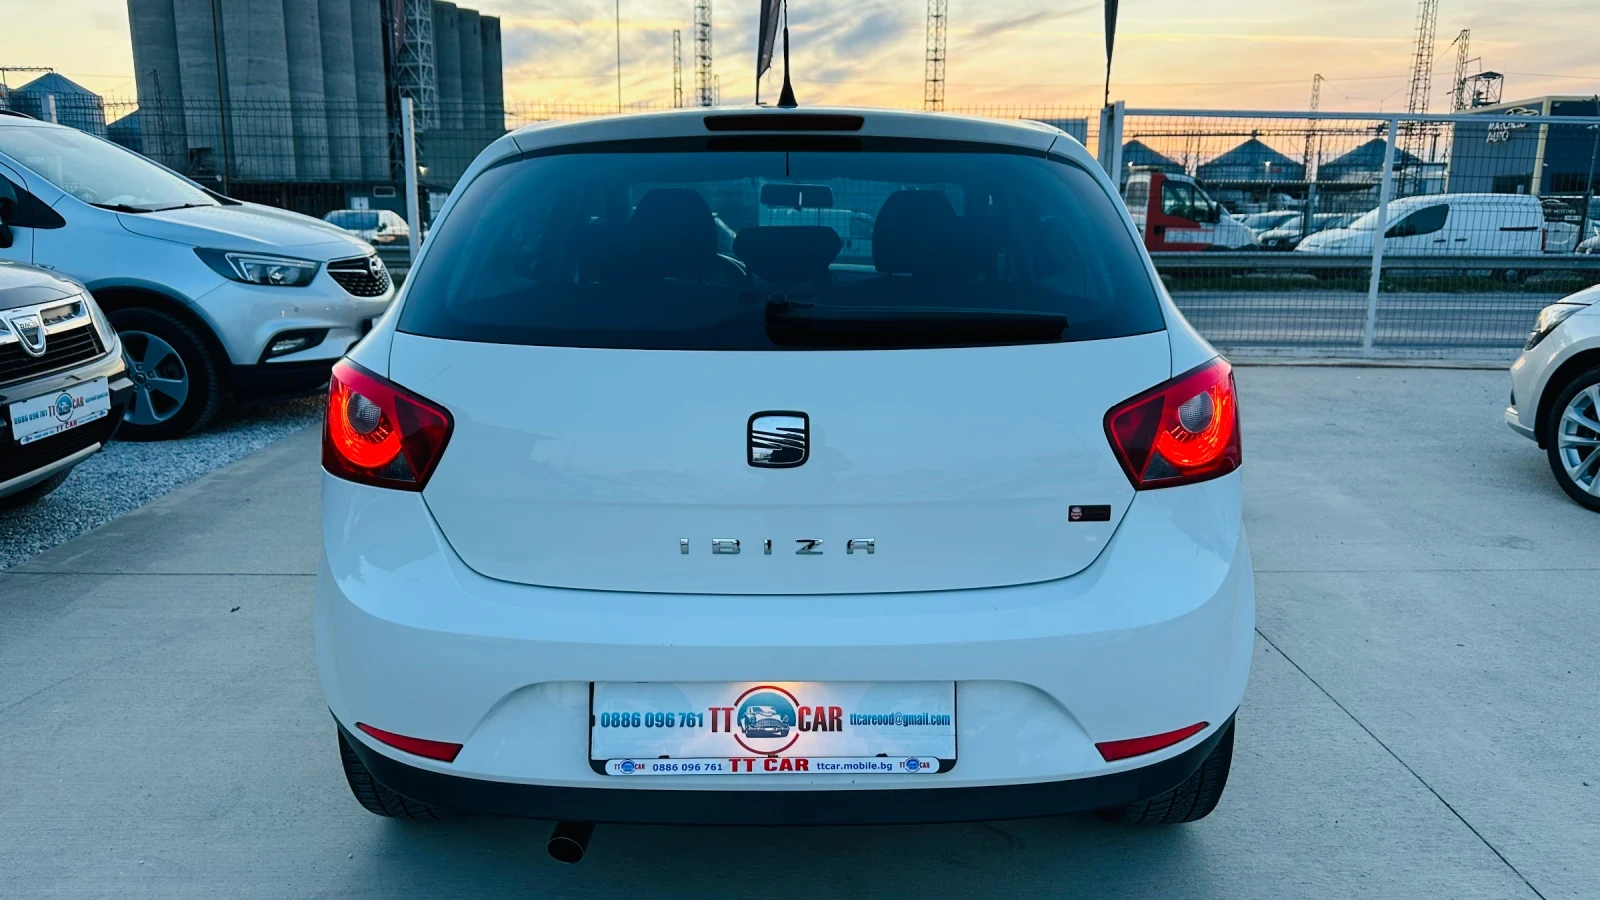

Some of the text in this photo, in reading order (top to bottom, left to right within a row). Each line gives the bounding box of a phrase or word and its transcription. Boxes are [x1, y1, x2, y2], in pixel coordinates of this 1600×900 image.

[1486, 130, 1509, 143] AUTO
[48, 405, 56, 417] TT
[72, 396, 85, 409] CAR
[56, 420, 77, 433] TT CAR
[680, 538, 875, 555] IBIZA
[600, 706, 951, 733] 0886 096 761 TT CAR ttcareood@gmail.com
[613, 763, 621, 771] TT
[652, 758, 893, 773] 0886 096 761 TT CAR ttcar.mobile.bg
[899, 761, 931, 769] TT CAR
